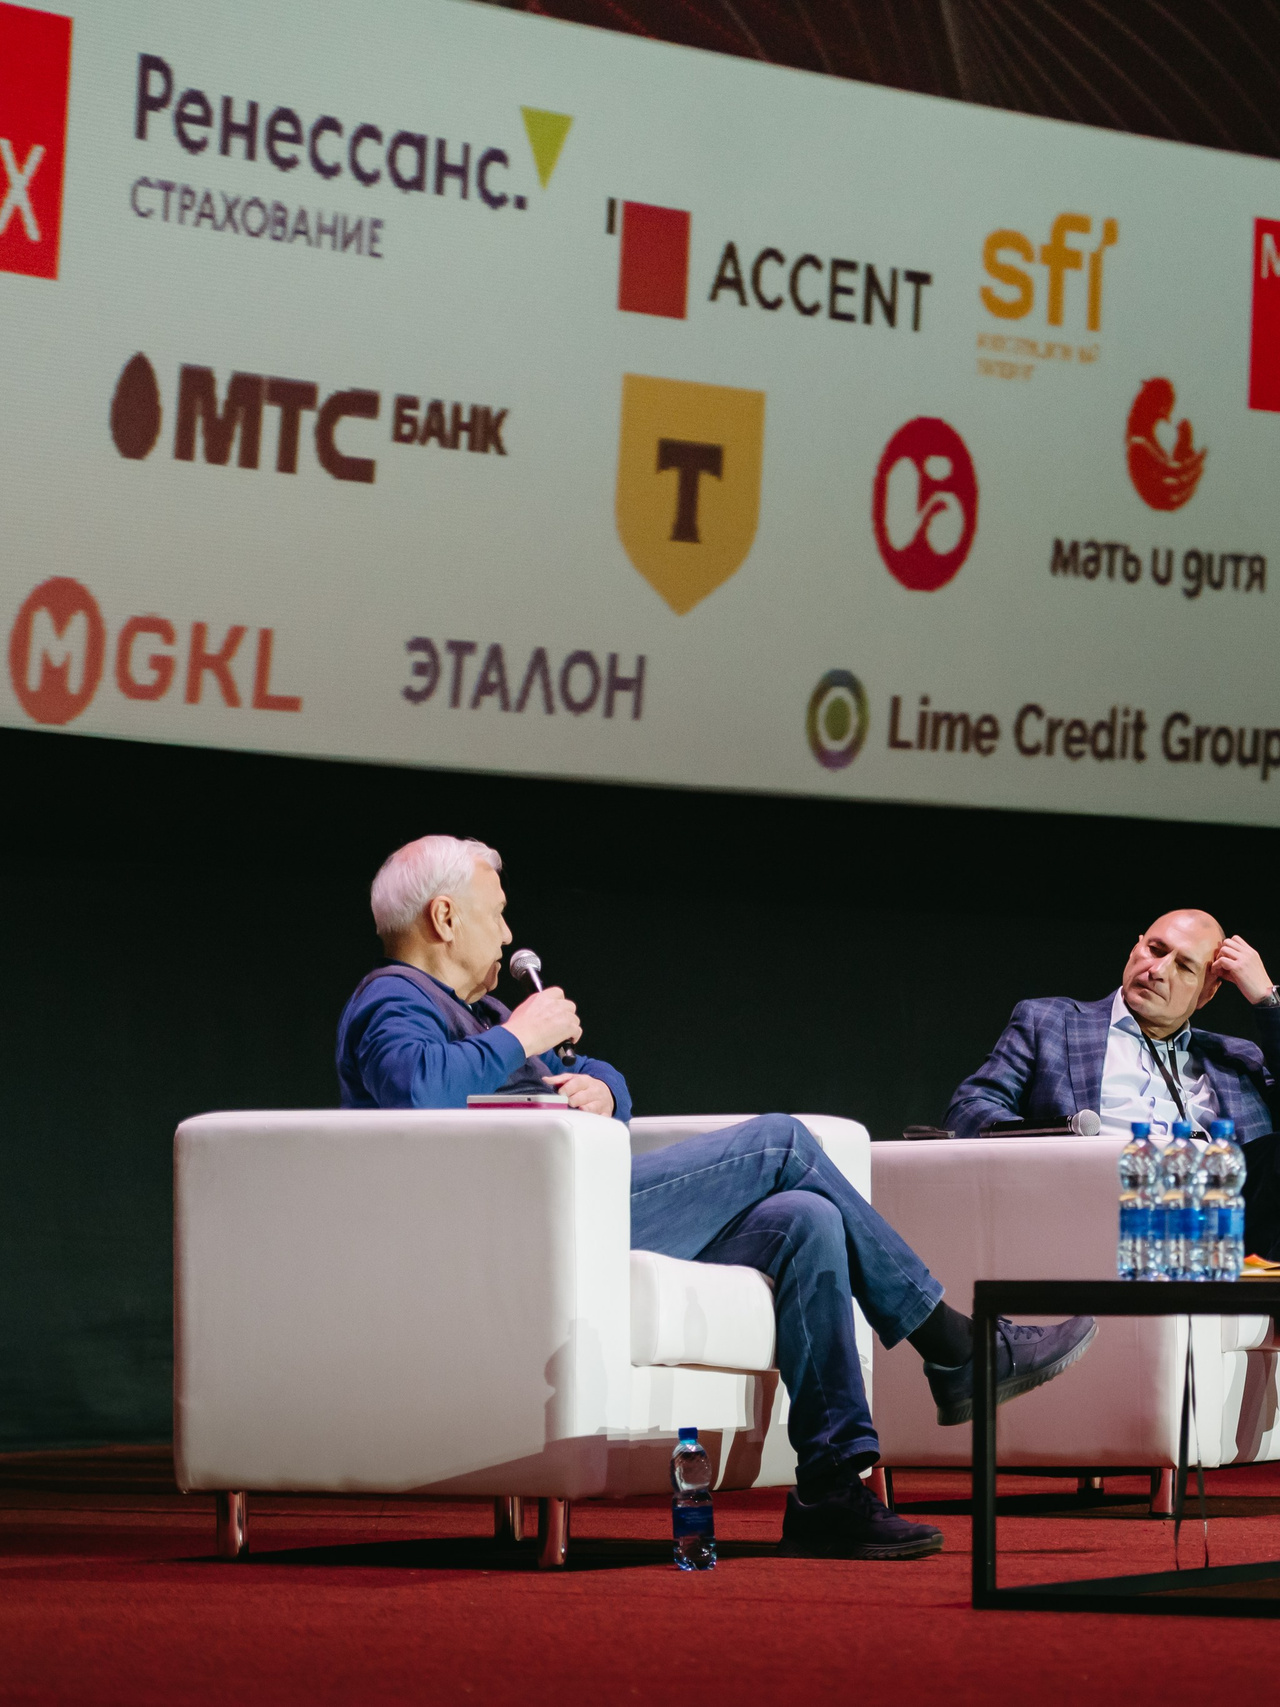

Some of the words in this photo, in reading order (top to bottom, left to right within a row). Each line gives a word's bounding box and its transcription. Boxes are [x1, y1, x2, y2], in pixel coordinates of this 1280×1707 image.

[131, 176, 384, 259] СТРАХОВАНИЕ
[709, 241, 933, 332] ACCENT
[980, 213, 1119, 332] sfi
[173, 364, 381, 484] МТС
[391, 394, 508, 456] БАНК
[402, 636, 646, 721] ЭТАЛОН
[887, 695, 1001, 758] Lime
[1013, 703, 1148, 764] Credit
